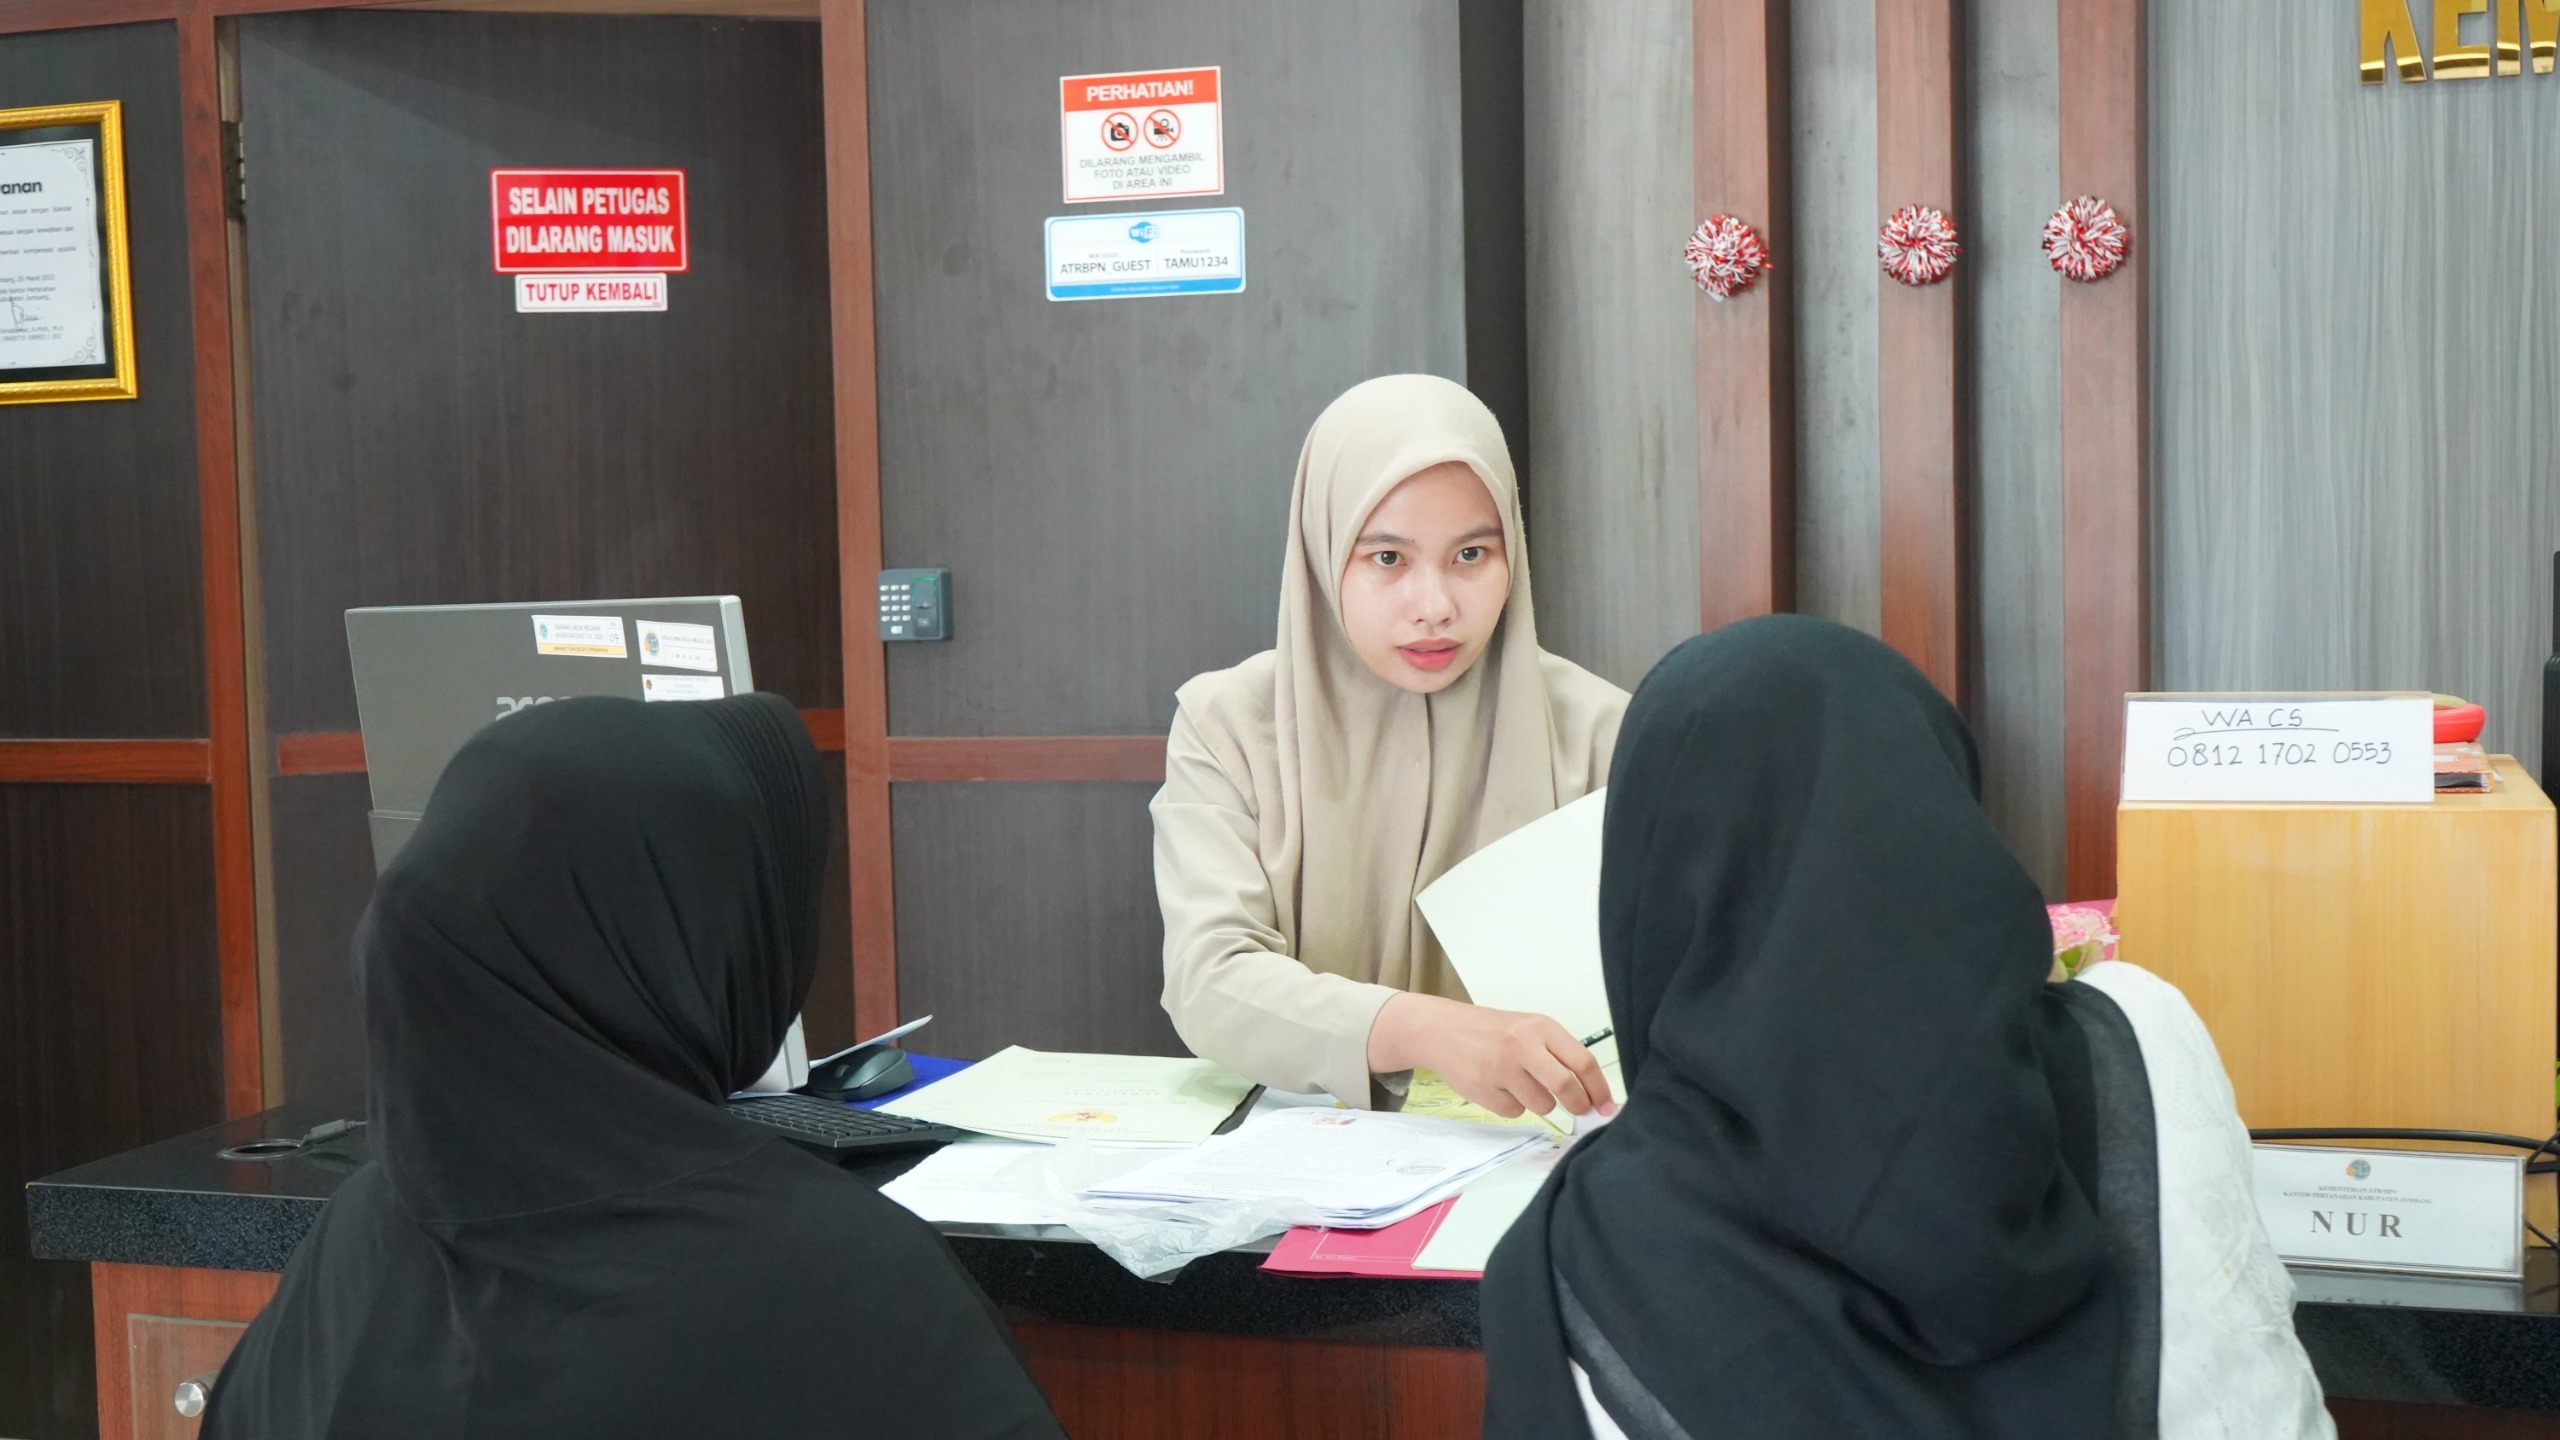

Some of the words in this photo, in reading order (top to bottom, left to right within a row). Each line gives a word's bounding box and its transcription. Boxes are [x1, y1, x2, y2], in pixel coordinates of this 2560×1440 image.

[1086, 79, 1194, 102] PERHATIAN!
[1079, 156, 1136, 169] DILARANG
[1139, 152, 1205, 165] MENGAMBIL
[1094, 169, 1124, 180] FOTO
[1127, 166, 1154, 177] ATAU
[1157, 164, 1191, 175] VIDEO
[0, 181, 42, 195] anan
[1113, 181, 1124, 190] DI
[1126, 178, 1156, 189] AREA
[1159, 177, 1173, 187] INI
[509, 187, 578, 215] SELAIN
[583, 187, 670, 214] PETUGAS
[506, 225, 603, 253] DILARANG
[607, 225, 675, 252] MASUK
[1164, 256, 1228, 269] TAMU1234
[526, 284, 579, 301] TUTUP
[586, 283, 657, 300] KEMBALI
[2201, 708, 2253, 727] WA
[2268, 708, 2303, 727] CS
[2167, 743, 2243, 767] 0812
[2258, 742, 2317, 766] 1702
[2333, 742, 2392, 765] 0553
[2310, 1210, 2403, 1238] NUR
